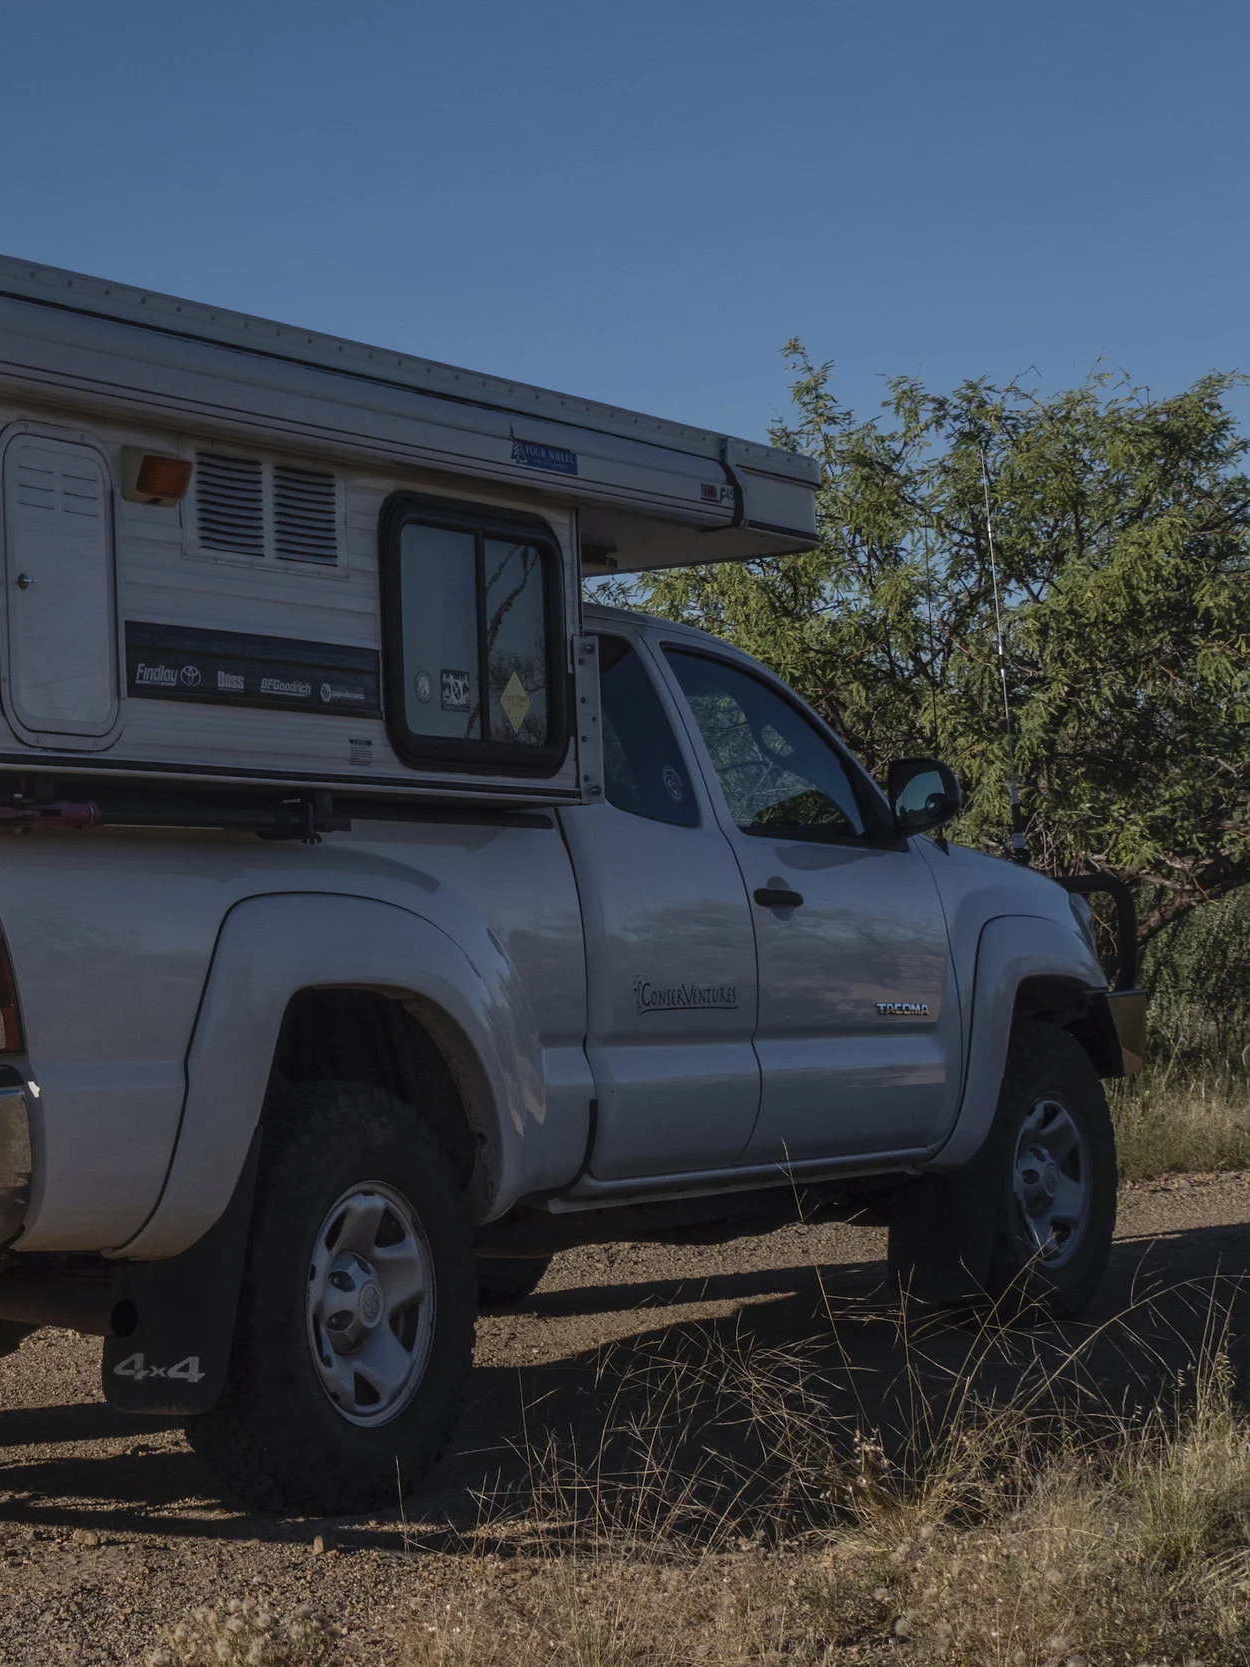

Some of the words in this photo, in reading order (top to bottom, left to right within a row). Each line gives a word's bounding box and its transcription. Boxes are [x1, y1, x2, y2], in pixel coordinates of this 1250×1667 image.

[135, 663, 178, 686] Findlay
[260, 677, 312, 696] BFGoodrich
[876, 1003, 931, 1016] TACOMA
[113, 1352, 206, 1383] 4x4
